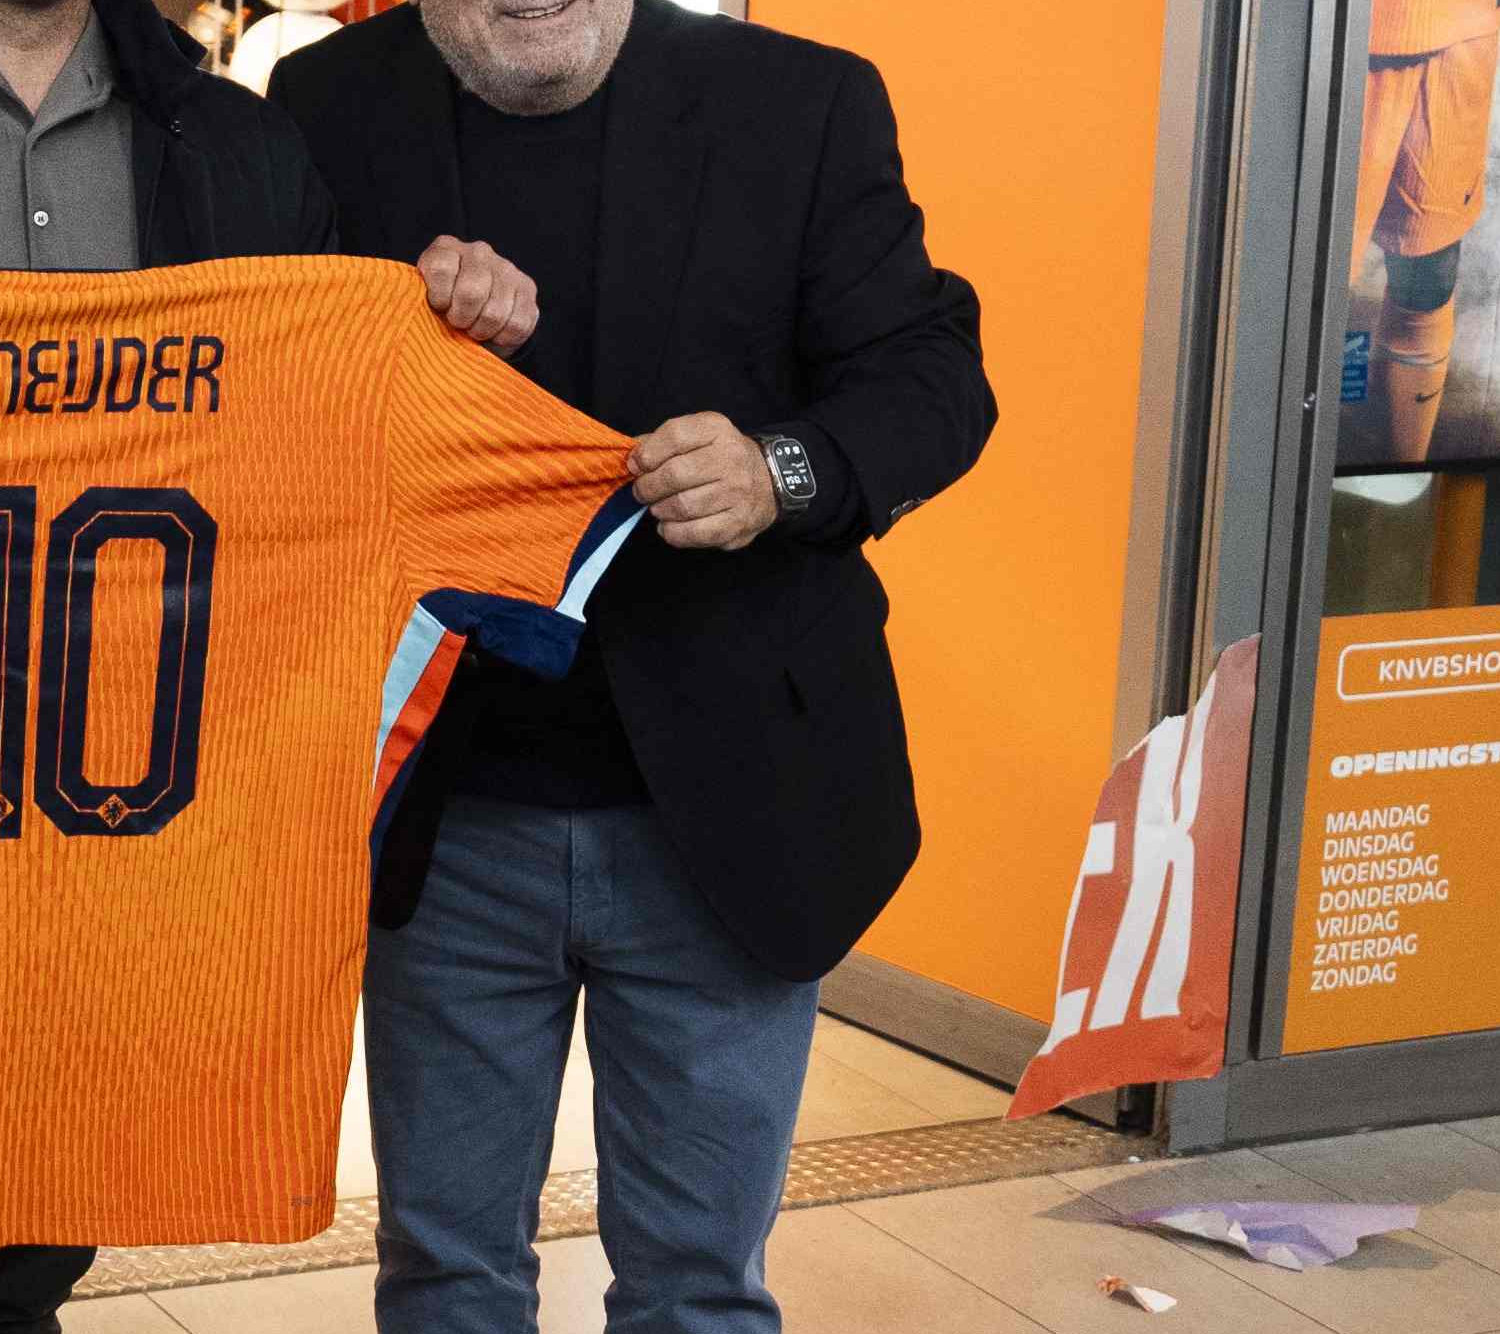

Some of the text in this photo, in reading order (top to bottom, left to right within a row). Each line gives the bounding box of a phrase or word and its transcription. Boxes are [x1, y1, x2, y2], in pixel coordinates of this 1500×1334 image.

[1325, 804, 1430, 834] MAANDAG
[1323, 831, 1415, 861] DINSDAG
[1321, 854, 1439, 887] WOENSDAG
[1319, 879, 1449, 913] DONDERDAG
[1316, 910, 1399, 940] VRIJDAG
[1313, 934, 1418, 966] ZATERDAG
[1310, 961, 1397, 991] ZONDAG
